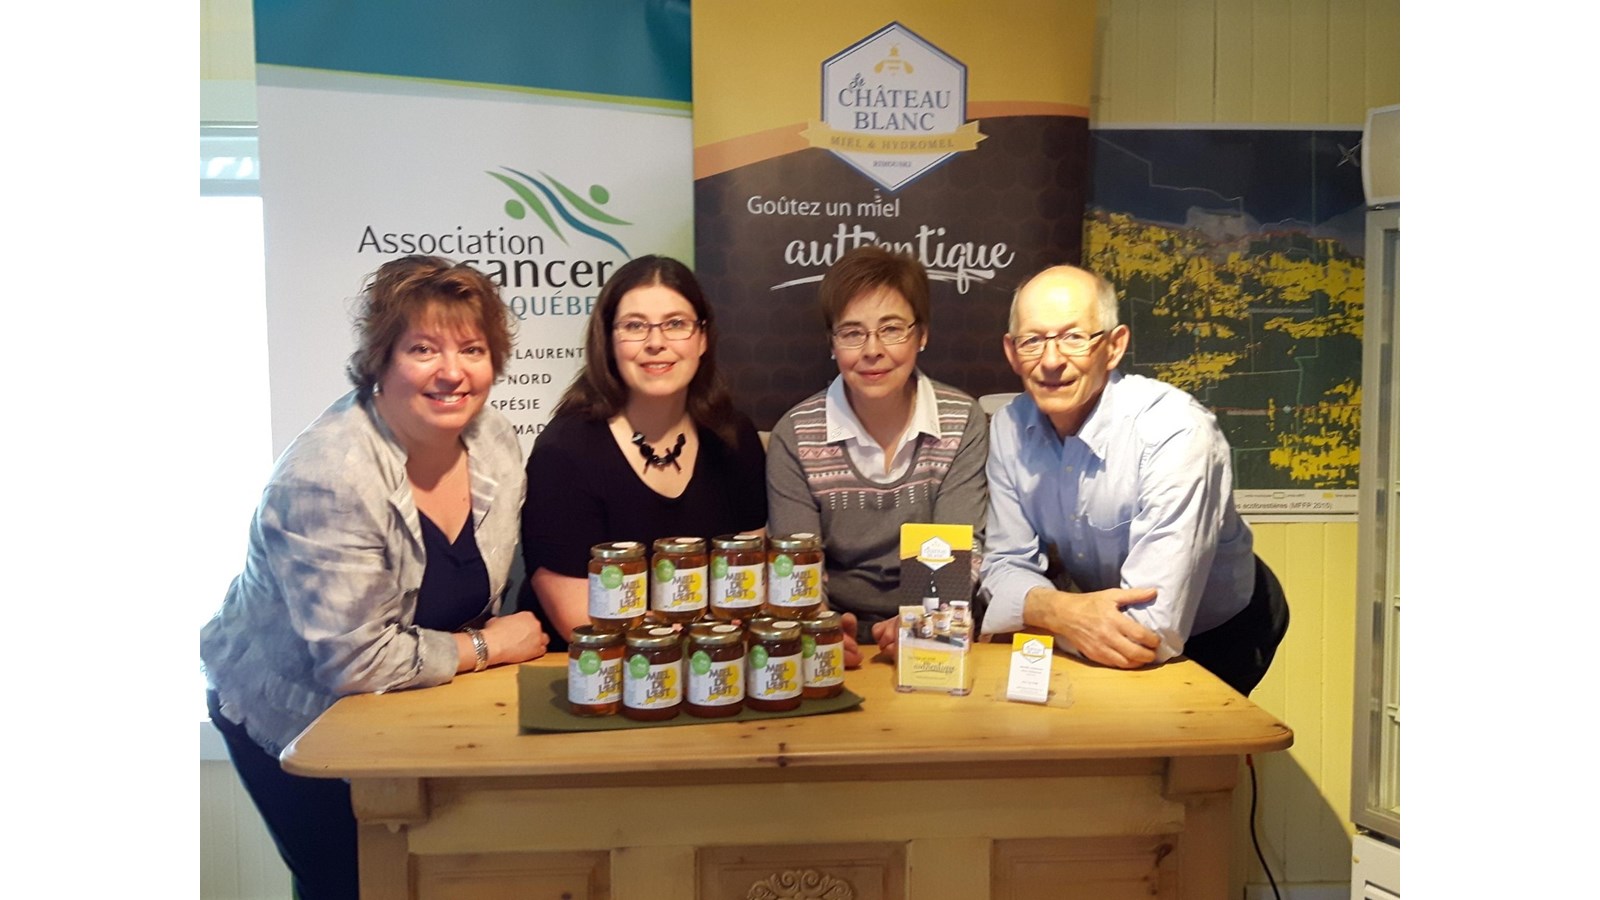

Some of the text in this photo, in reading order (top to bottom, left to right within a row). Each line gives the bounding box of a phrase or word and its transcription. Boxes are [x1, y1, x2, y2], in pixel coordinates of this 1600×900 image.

[838, 84, 951, 109] CHÂTEAU
[854, 111, 935, 131] BLANC
[830, 135, 955, 150] MIEL & HYDROMEL
[747, 195, 900, 218] Goûtez un miel
[358, 225, 544, 255] Association
[510, 290, 597, 320] QUÉBE
[490, 396, 540, 411] SPÉSIE
[672, 574, 695, 585] MIEL
[725, 570, 748, 581] MIEL
[790, 570, 812, 581] MIEL
[619, 579, 641, 591] MIEL
[678, 584, 690, 593] DE
[730, 580, 742, 589] DE
[796, 579, 808, 588] DE
[625, 589, 636, 599] DE
[814, 650, 835, 661] MIEL
[765, 662, 789, 673] MIEL
[819, 660, 832, 669] DE
[646, 671, 671, 682] MIEL
[708, 666, 733, 678] MIEL
[771, 672, 784, 681] DE
[604, 675, 615, 685] DE
[652, 680, 665, 690] DE
[714, 677, 727, 687] DE
